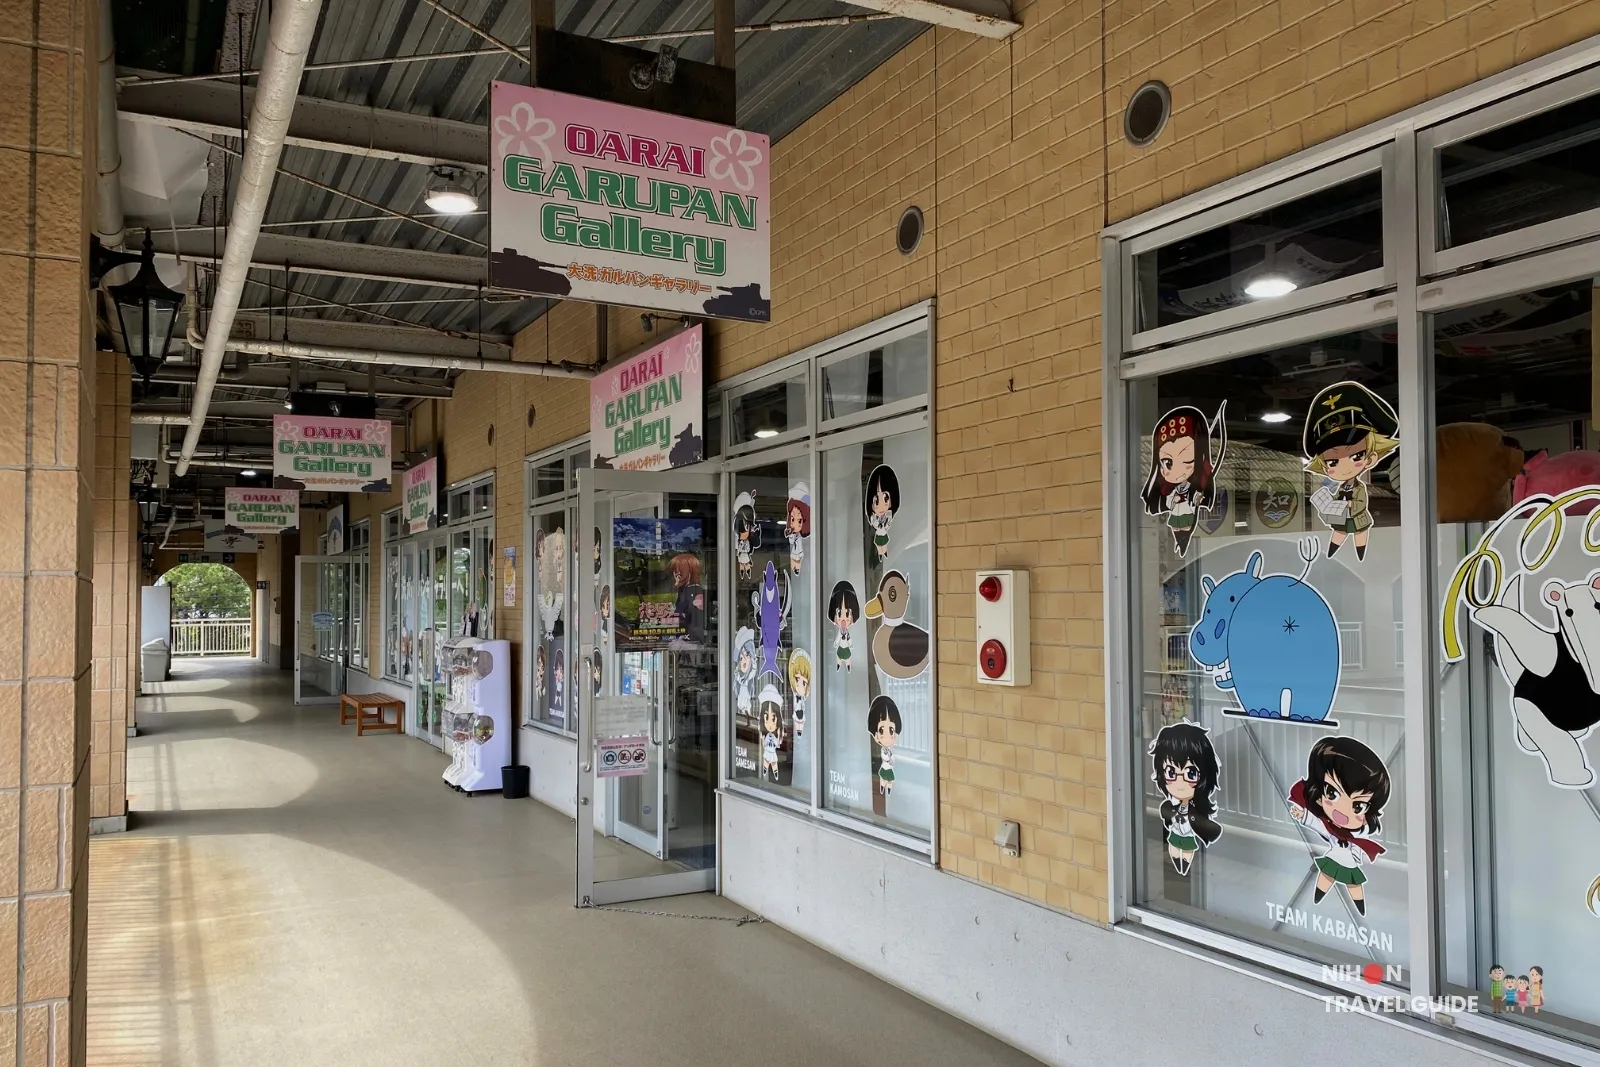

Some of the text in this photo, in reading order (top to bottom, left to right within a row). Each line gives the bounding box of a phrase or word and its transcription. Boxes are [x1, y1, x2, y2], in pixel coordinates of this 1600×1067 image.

[564, 123, 705, 178] OARAI
[503, 154, 758, 230] GARUPAN
[540, 203, 727, 276] Gallery
[567, 262, 712, 295] 大洗ガルパンギャラリー
[620, 351, 663, 393] OARAI
[605, 371, 683, 430] GARUPAN
[302, 426, 364, 441] OARAI
[614, 415, 671, 456] Gallery
[278, 439, 386, 459] GARUPAN
[293, 456, 373, 478] Gallery
[227, 502, 296, 514] GARUPAN
[242, 494, 281, 503] OARAI
[236, 512, 287, 526] Gallery
[735, 745, 748, 758] TEAM
[735, 757, 756, 771] SAMESAN
[829, 770, 845, 784] TEAM
[829, 783, 859, 802] KAMOSAN
[1265, 901, 1393, 953] TEAM KABASAN
